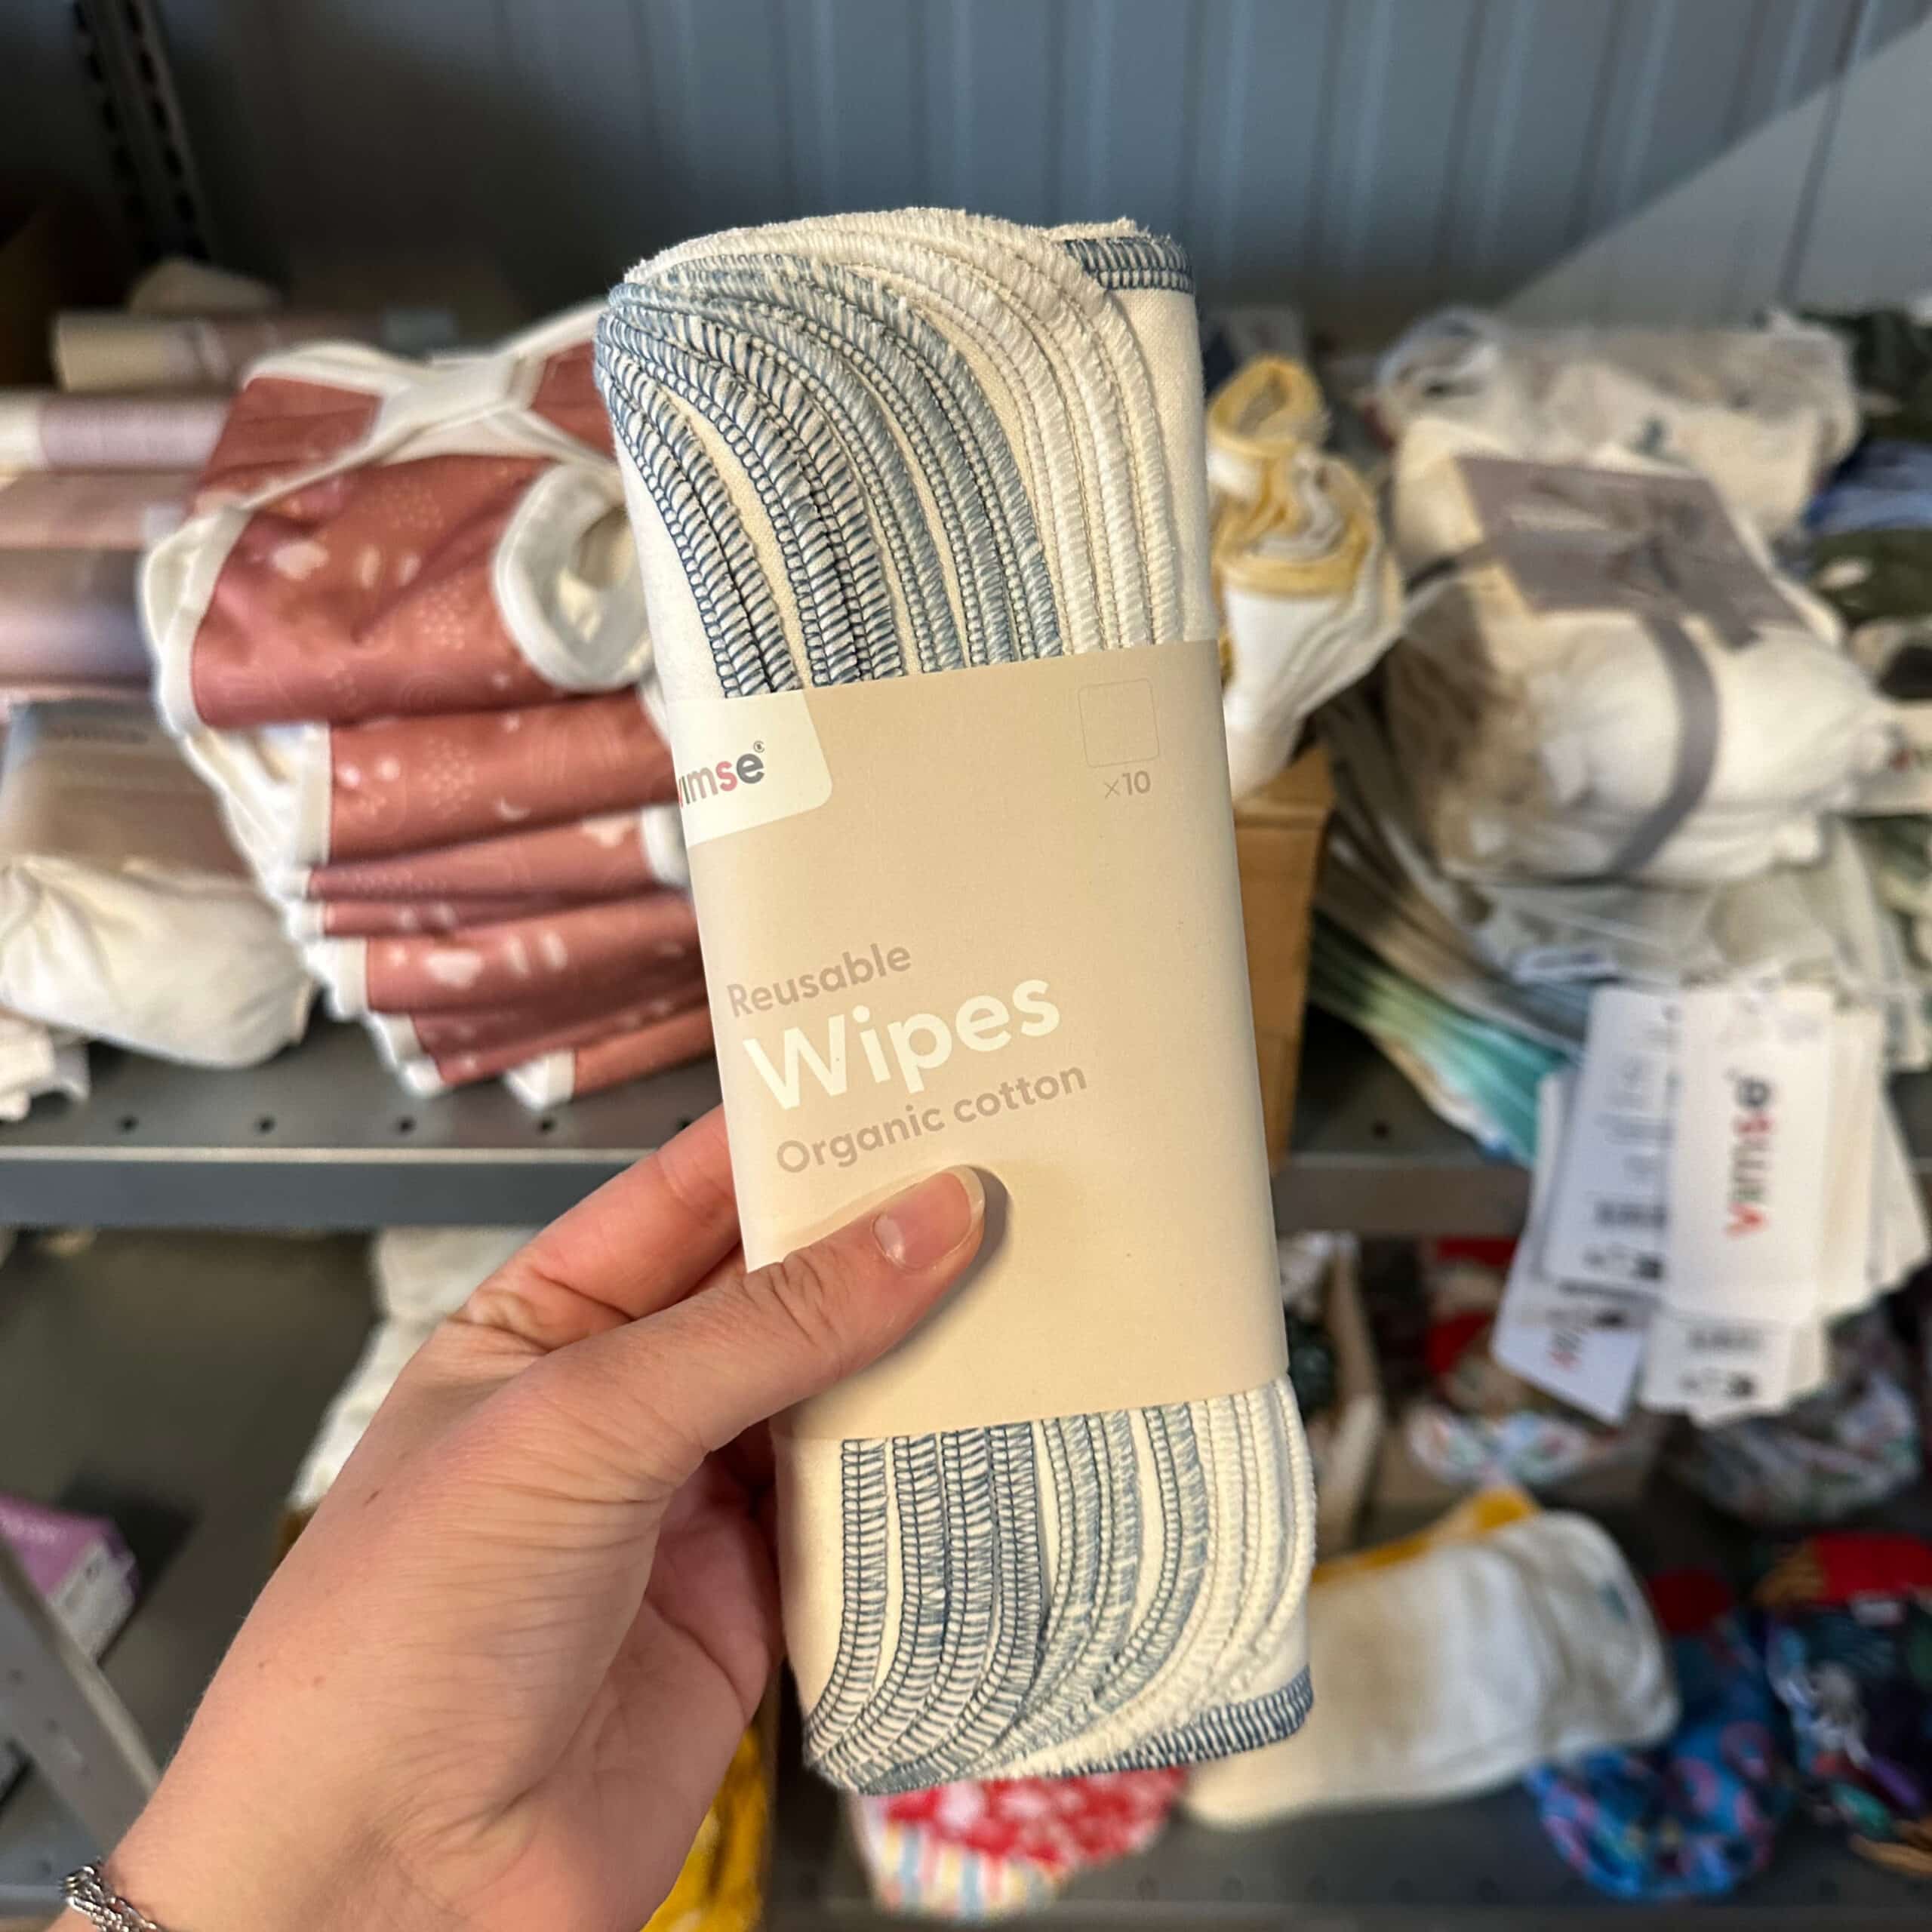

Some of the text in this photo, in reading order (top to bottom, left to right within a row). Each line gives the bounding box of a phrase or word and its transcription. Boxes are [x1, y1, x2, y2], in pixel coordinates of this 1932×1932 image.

[1103, 770, 1151, 799] x10
[727, 943, 912, 1017] Reusable
[743, 979, 1060, 1110] Wipes
[777, 1066, 1088, 1173] Organic cotton
